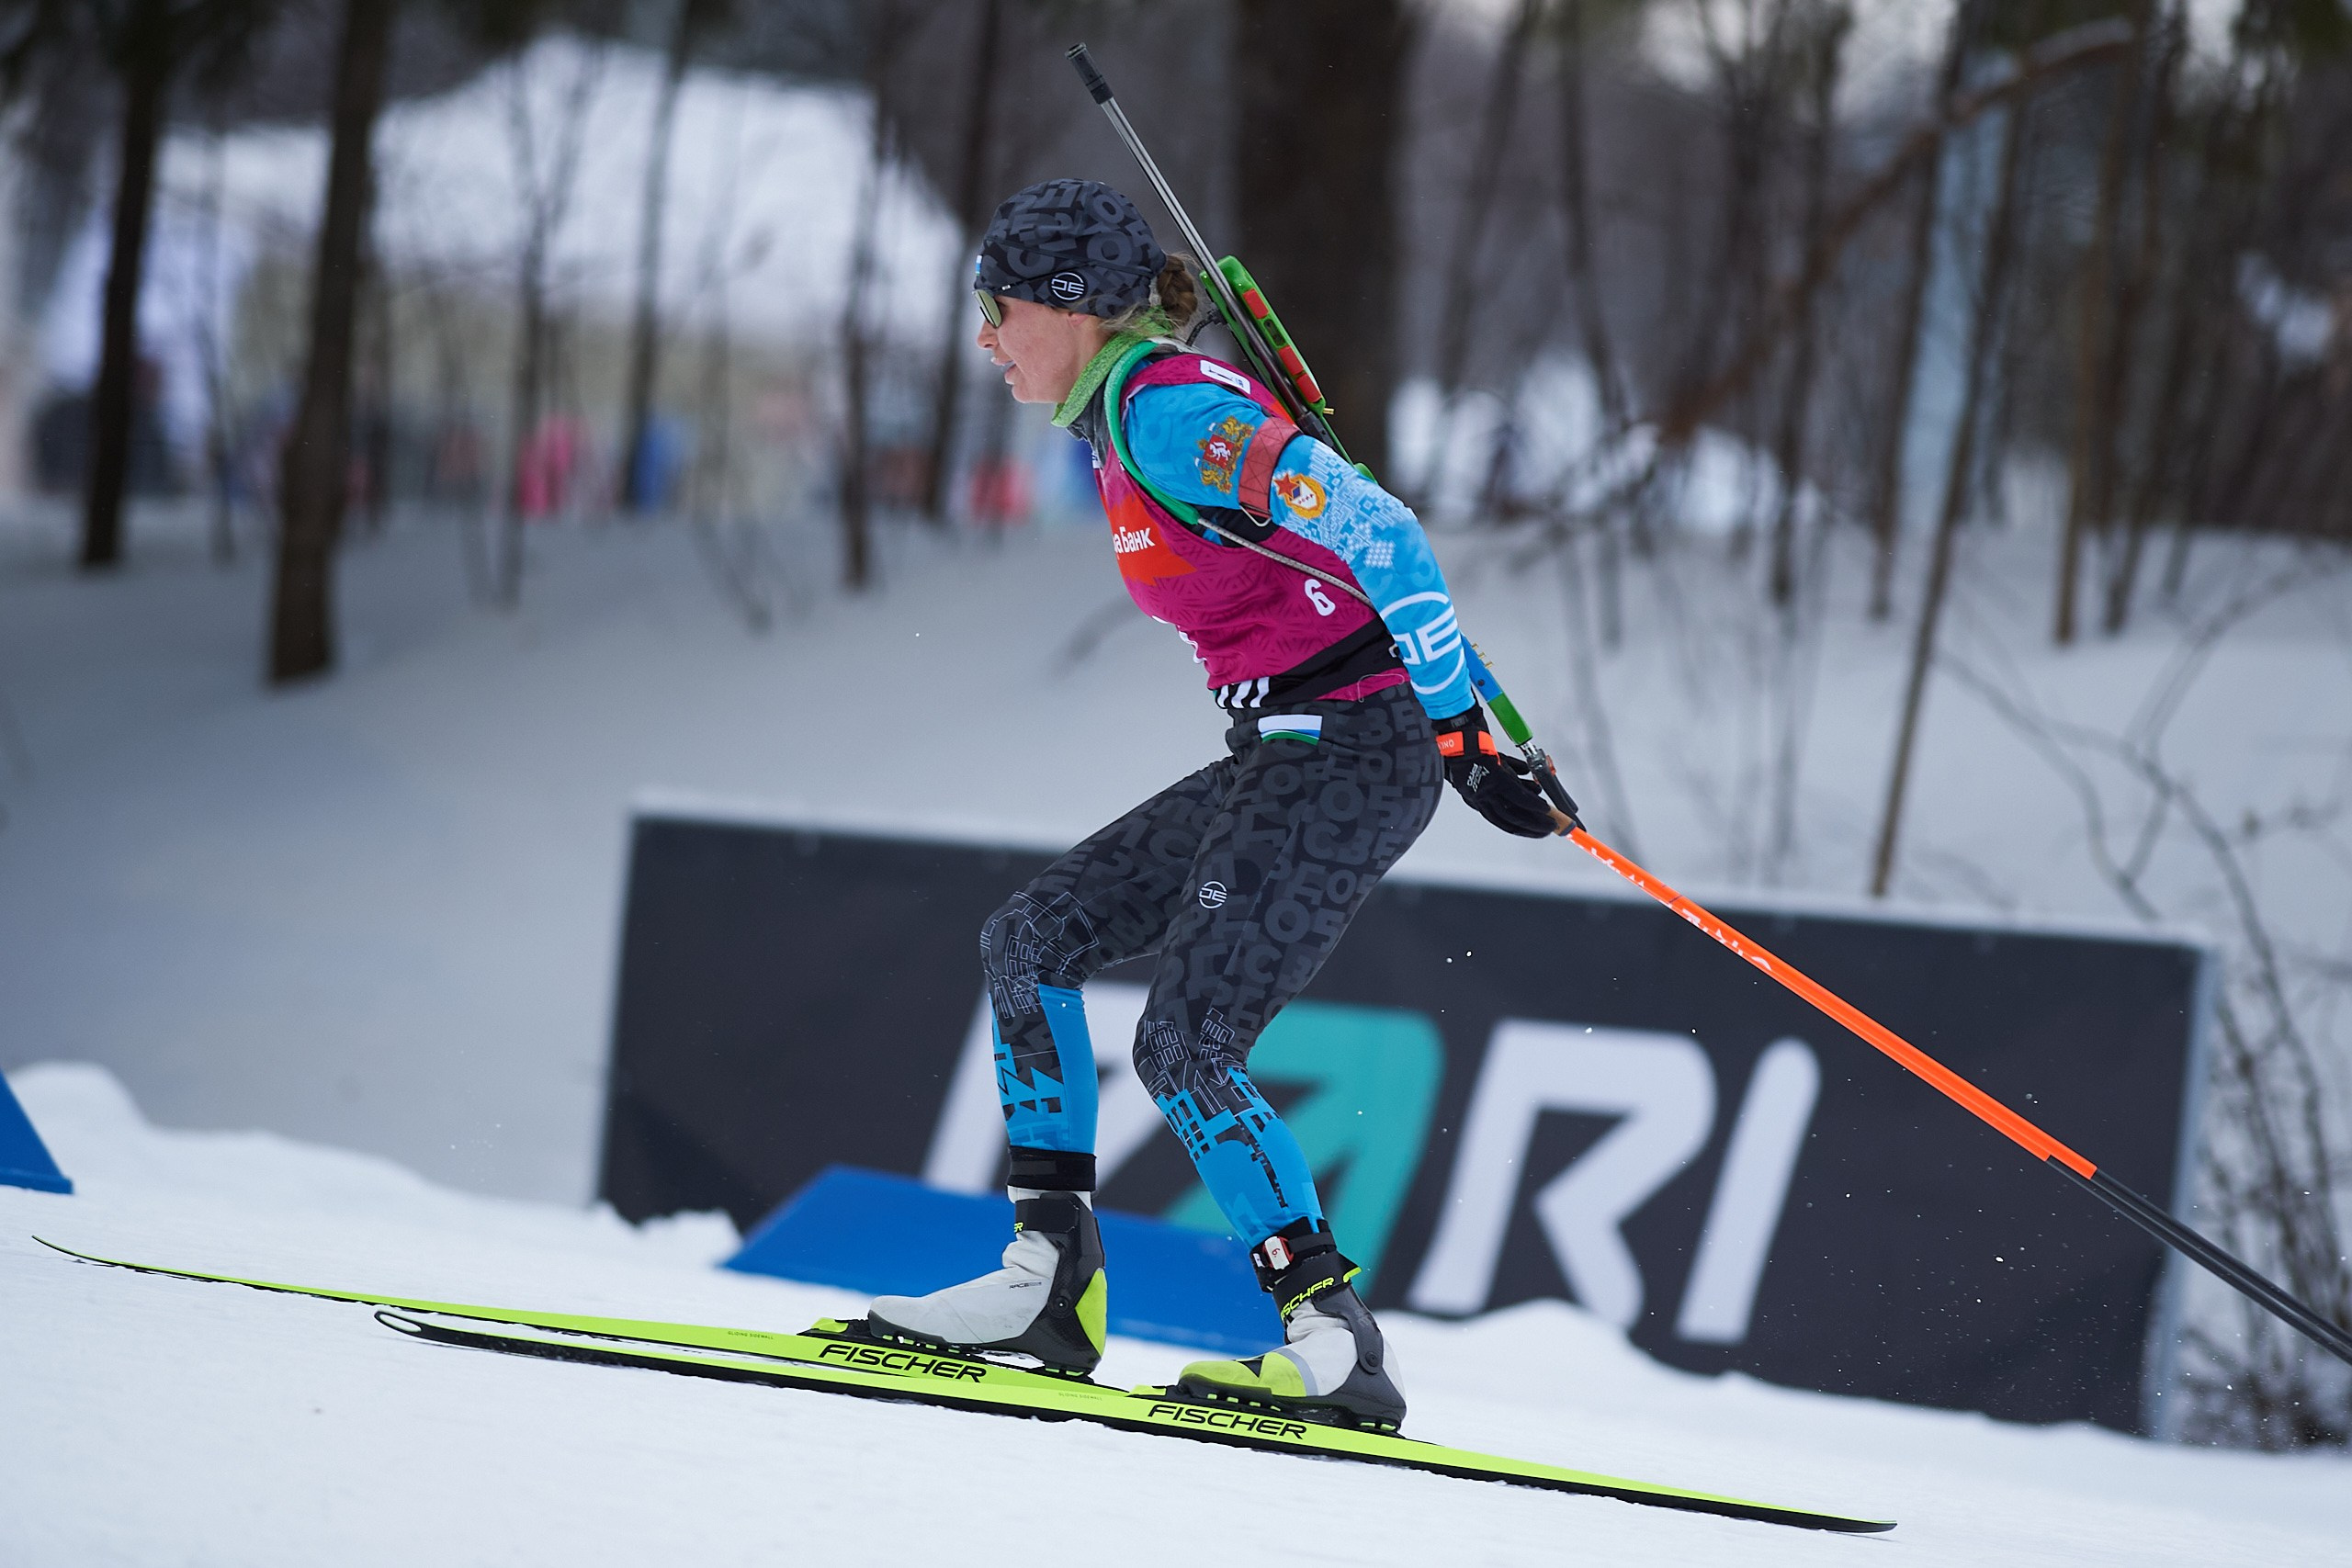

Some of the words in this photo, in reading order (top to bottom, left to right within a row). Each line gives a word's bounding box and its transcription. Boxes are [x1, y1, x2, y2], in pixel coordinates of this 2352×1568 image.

[1305, 579, 1336, 616] 6
[1281, 1277, 1335, 1319] SCHER
[819, 1344, 987, 1383] FISCHER
[1148, 1404, 1307, 1439] FISCHER
